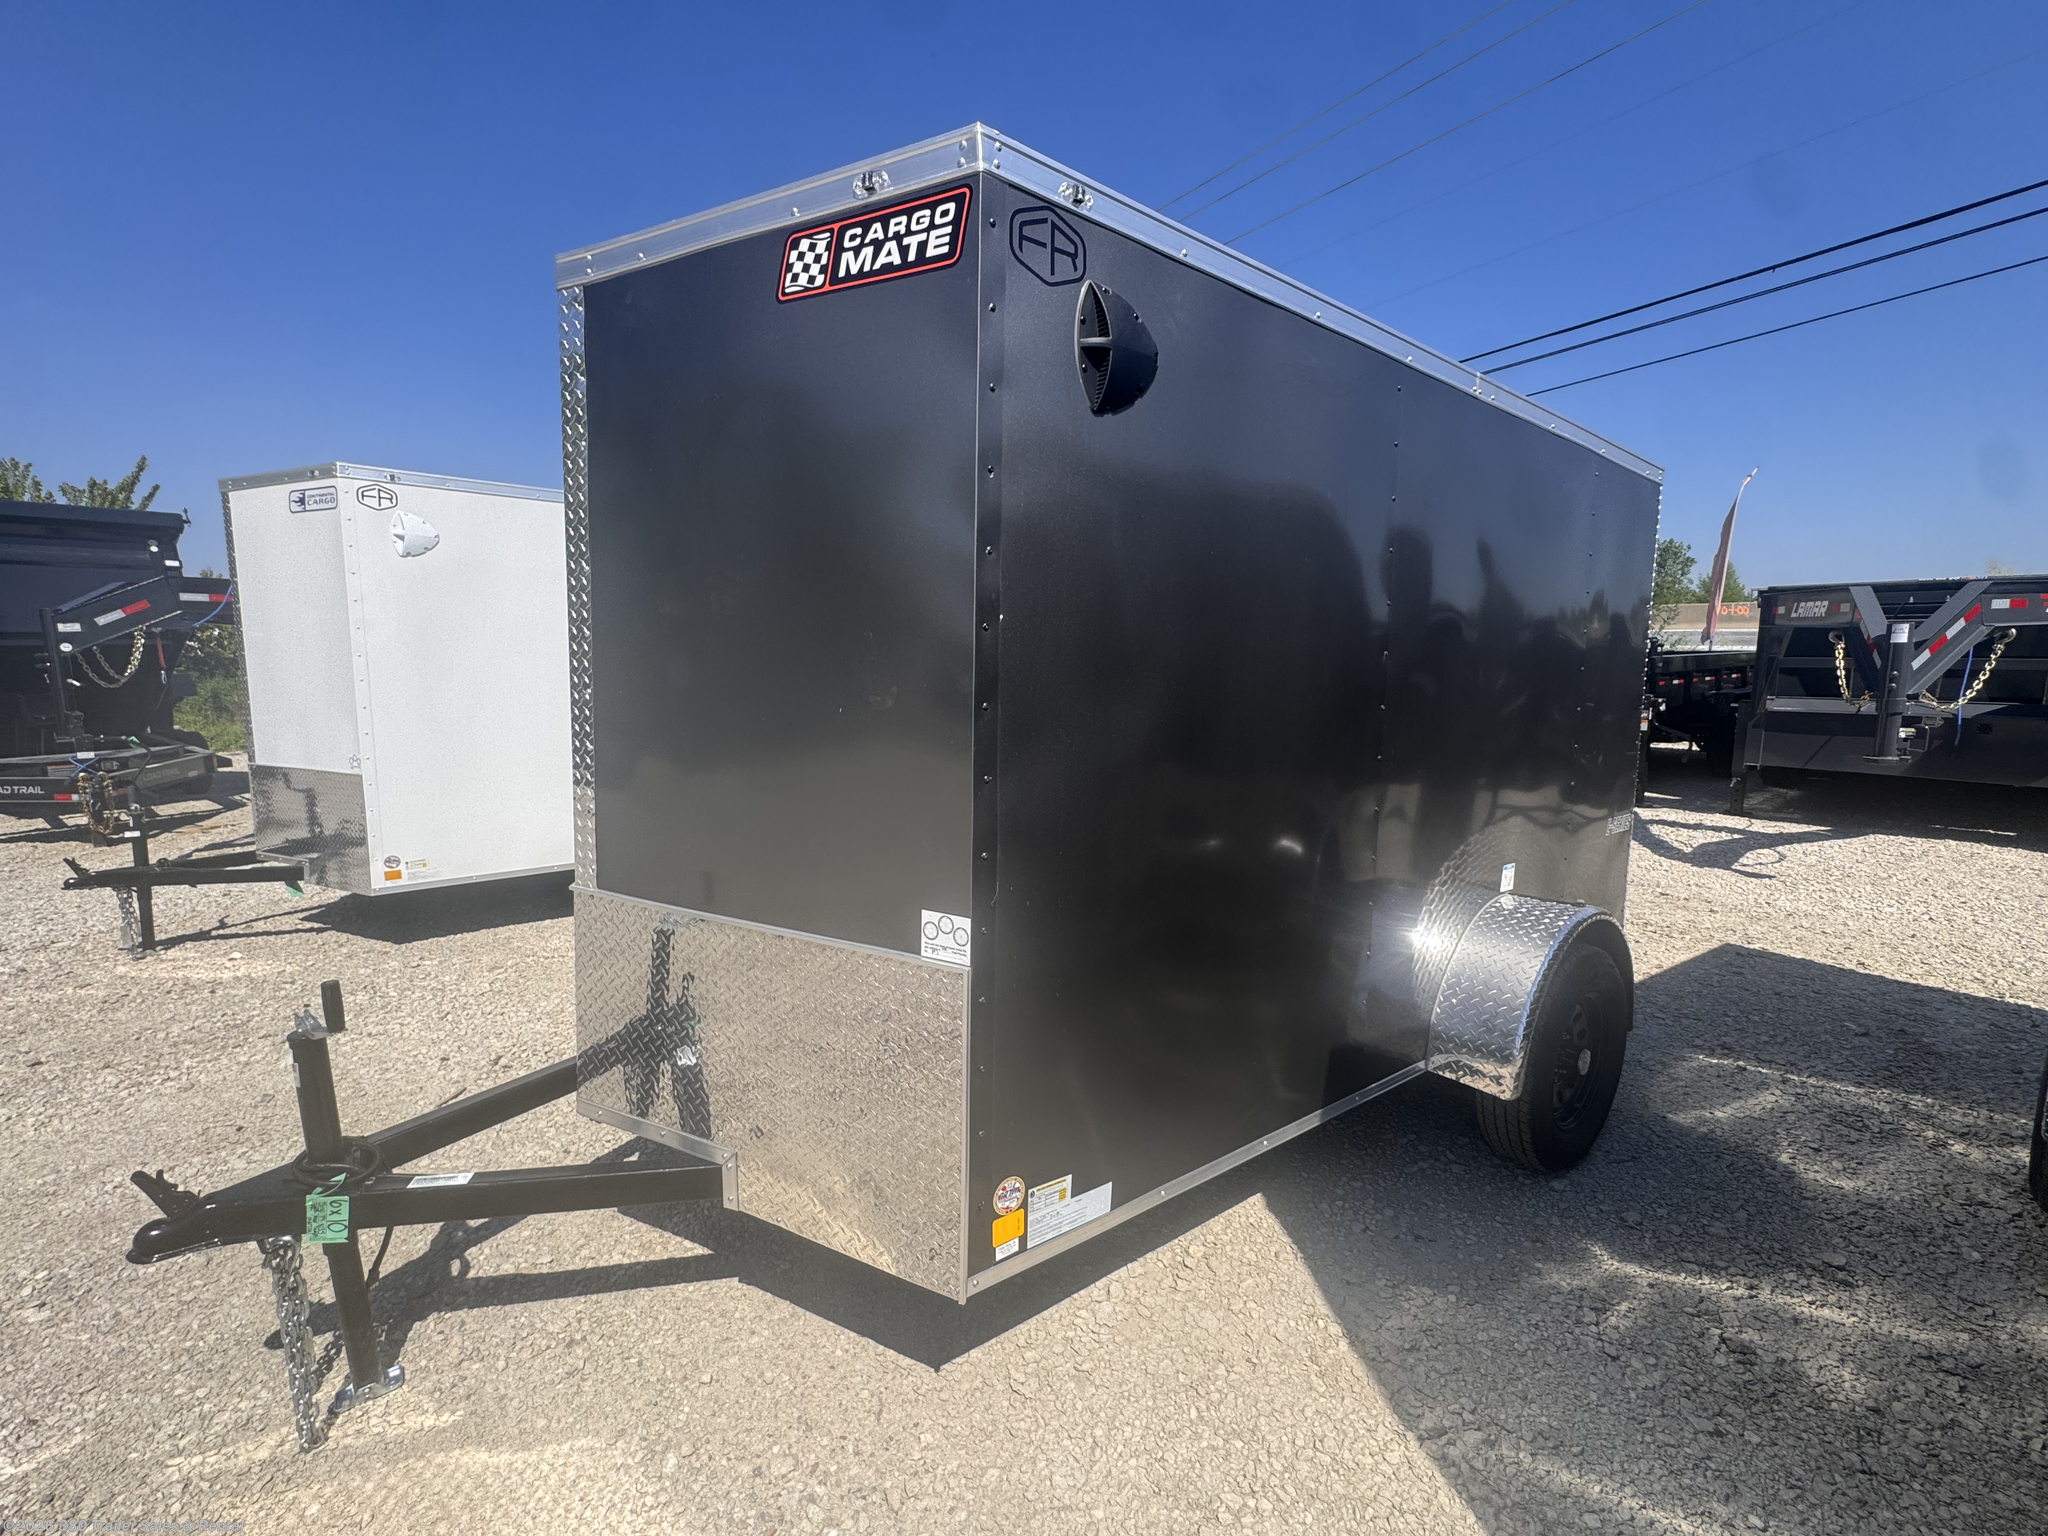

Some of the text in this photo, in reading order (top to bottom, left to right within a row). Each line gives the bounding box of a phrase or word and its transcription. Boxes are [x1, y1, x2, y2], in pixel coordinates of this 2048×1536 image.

[843, 201, 956, 249] CARGO
[837, 225, 954, 279] MATE
[307, 496, 336, 506] CARGO
[1790, 600, 1829, 618] LAMAR
[12, 786, 45, 794] TRAIL
